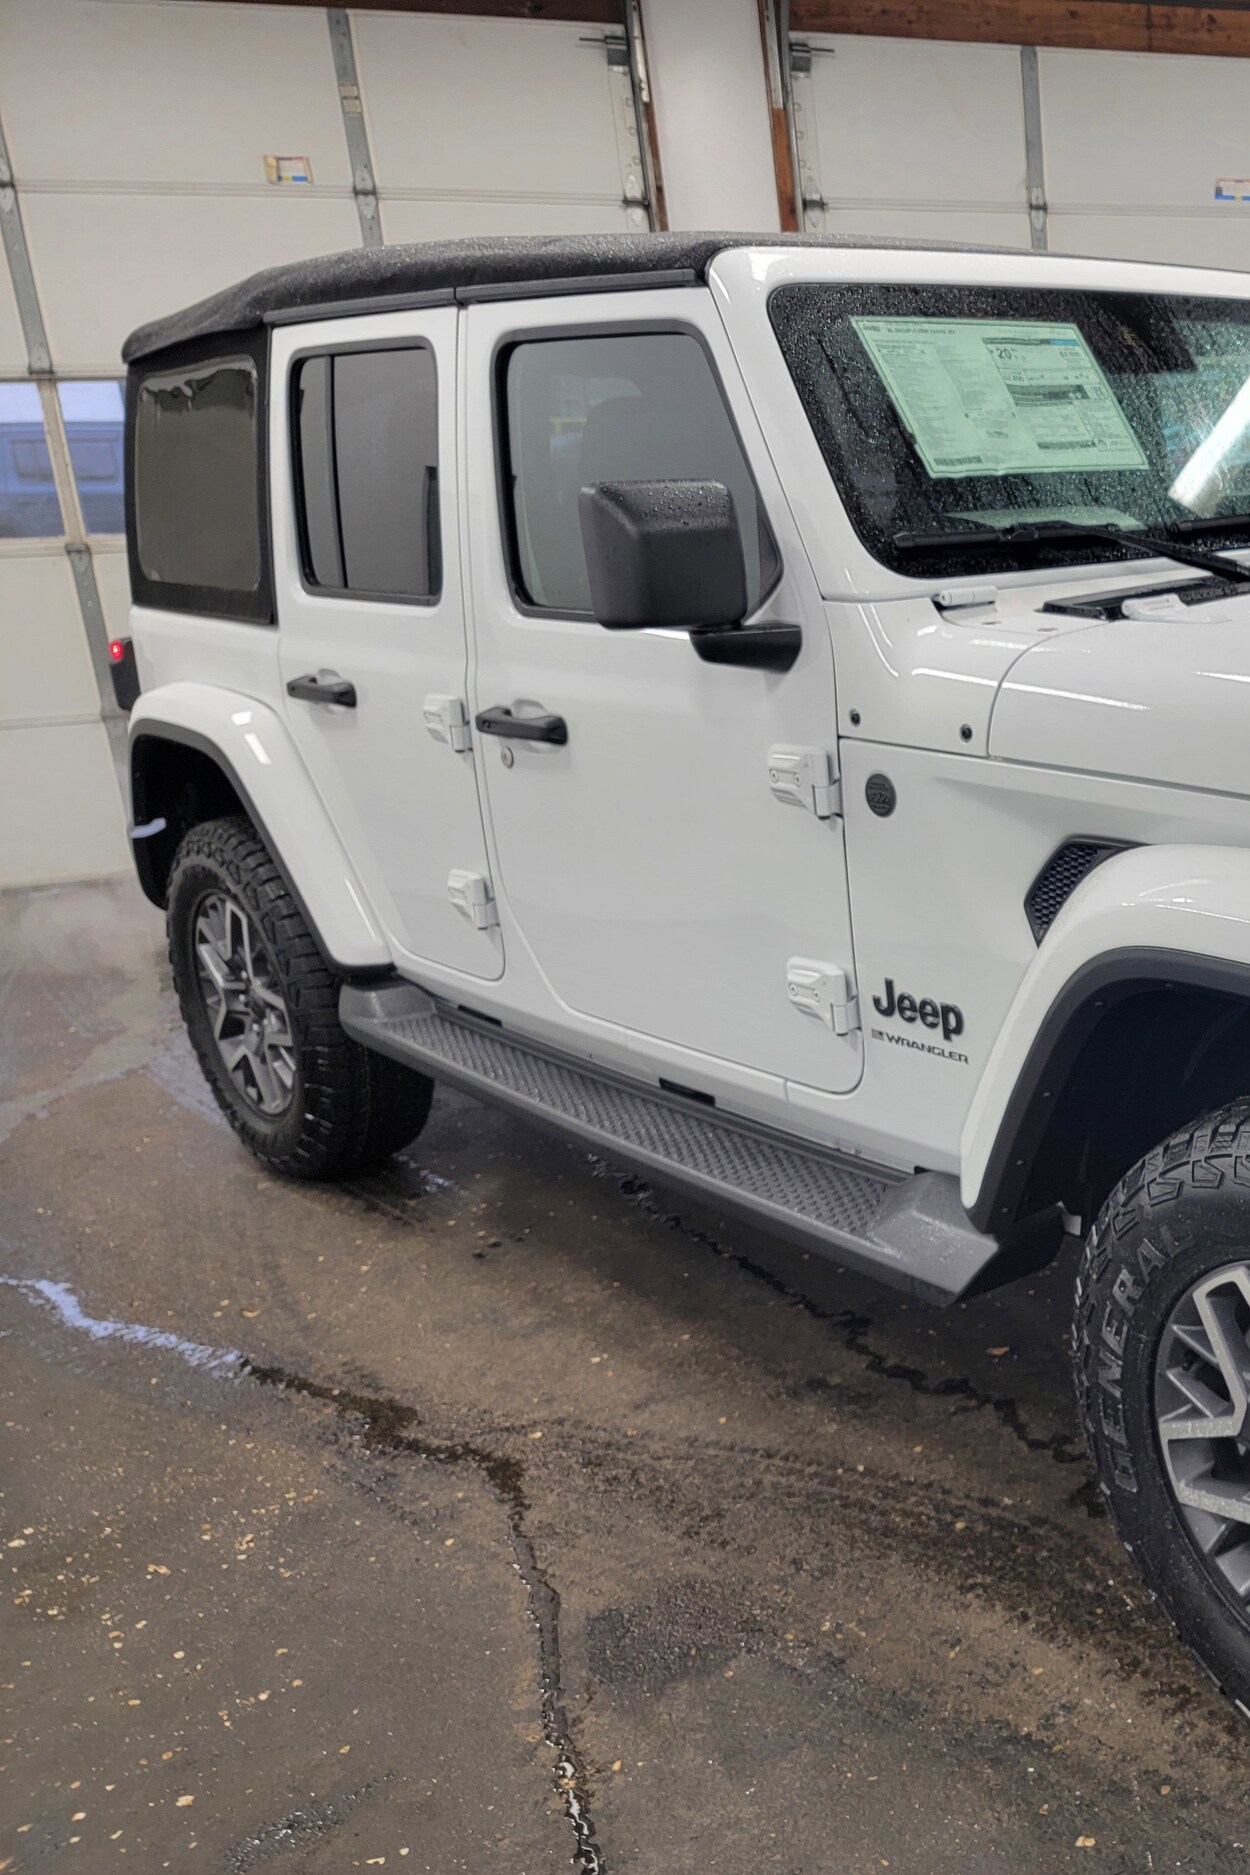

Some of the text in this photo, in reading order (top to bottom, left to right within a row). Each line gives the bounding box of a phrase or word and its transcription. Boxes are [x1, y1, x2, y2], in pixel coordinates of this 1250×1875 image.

[996, 347, 1013, 361] 20
[872, 977, 965, 1043] Jeep
[885, 1031, 970, 1066] WRANGLER
[1098, 1223, 1197, 1494] GENERAL
